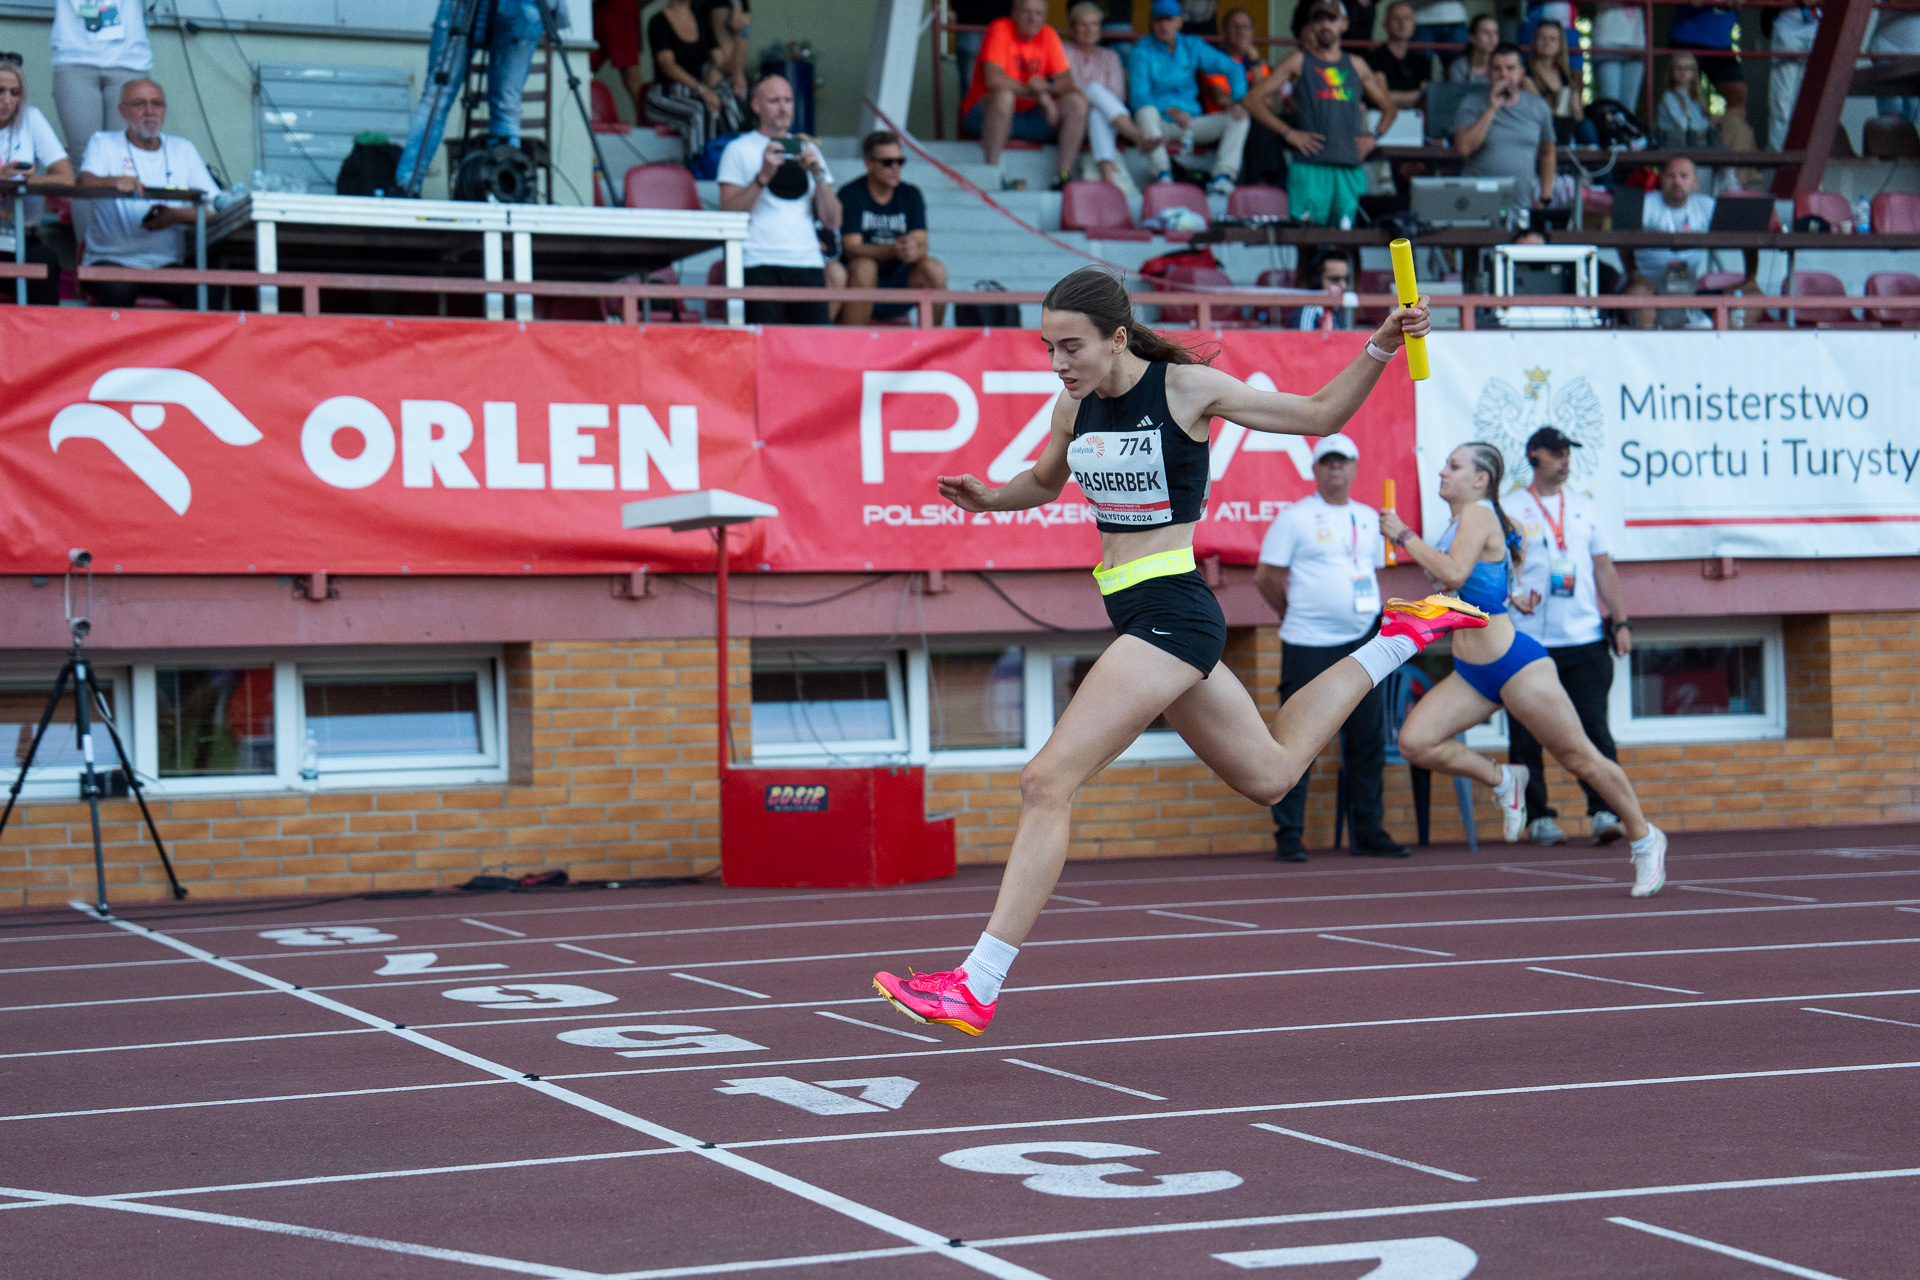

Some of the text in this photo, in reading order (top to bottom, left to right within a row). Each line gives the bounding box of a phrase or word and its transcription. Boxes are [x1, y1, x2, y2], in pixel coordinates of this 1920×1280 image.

[1620, 382, 1869, 421] Ministerstwo
[300, 394, 700, 491] ORLEN
[860, 370, 1317, 484] PZA
[1119, 436, 1153, 456] 774
[1620, 438, 1920, 486] Sportu i Turysty
[1074, 470, 1162, 492] PASIERBEK
[863, 504, 965, 526] POLSKI
[1214, 501, 1297, 522] ATLET
[1132, 514, 1153, 522] 2024
[1099, 568, 1130, 592] NIKE
[1133, 556, 1181, 579] PRO
[258, 926, 399, 946] 8
[373, 952, 510, 976] 7
[441, 983, 620, 1009] 6
[556, 1024, 771, 1058] 5
[713, 1076, 921, 1116] 4
[938, 1141, 1245, 1199] 3
